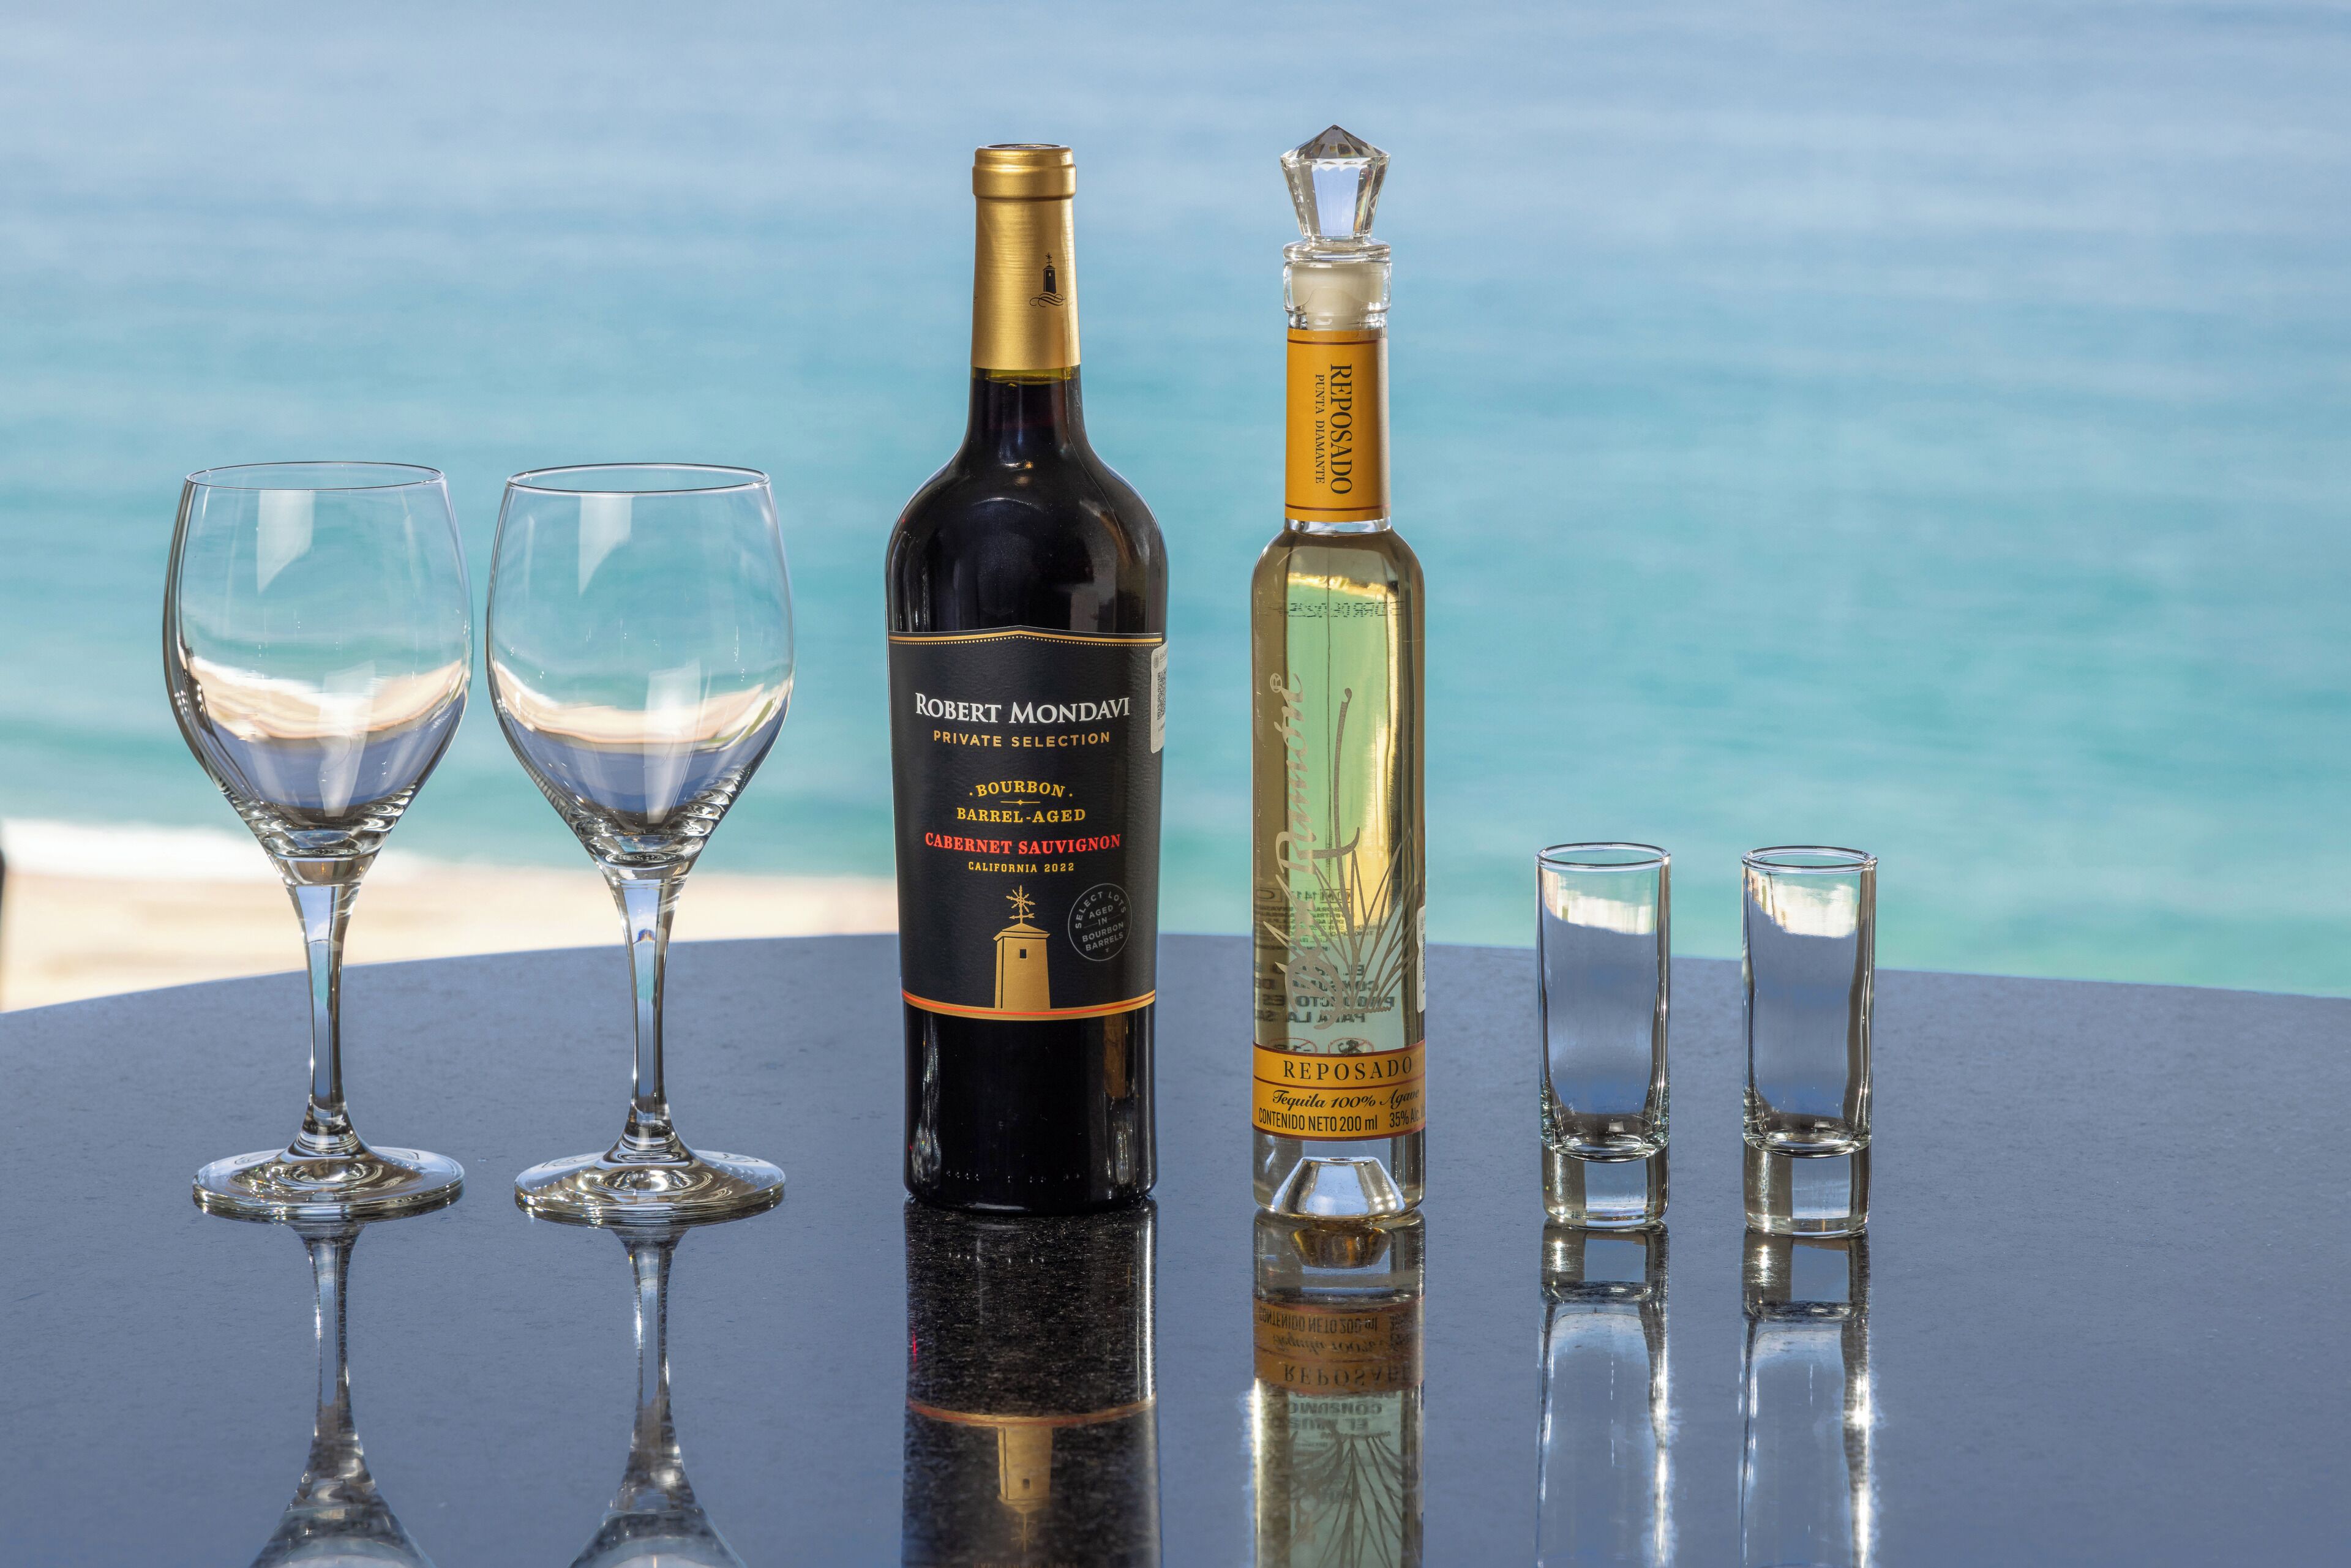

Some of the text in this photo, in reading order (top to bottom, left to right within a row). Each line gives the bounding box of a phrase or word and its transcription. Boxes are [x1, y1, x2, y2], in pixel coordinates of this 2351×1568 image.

[1315, 374, 1325, 484] PUNTA DIAMANTE
[1330, 363, 1352, 494] REPOSADO
[915, 692, 1130, 723] ROBERT MONDAVI
[934, 730, 1110, 748] PRIVATE SELECTION
[976, 781, 1065, 797] BOURBON
[957, 808, 1086, 823] BARREL-AGED
[925, 833, 1121, 855] CABERNET SAUVIGNON
[969, 861, 1074, 872] CALIFORNIA 2022
[1075, 891, 1127, 929] SELECT LOTS
[1089, 905, 1114, 919] AGED
[1082, 921, 1124, 942] BOURBON
[1098, 917, 1107, 926] IN
[1086, 932, 1123, 951] BARRELS
[1283, 1056, 1412, 1081] REPOSADO
[1273, 1088, 1419, 1111] Tequila 100% Agave
[1259, 1107, 1305, 1130] CONTENIDO
[1308, 1115, 1337, 1131] NETO
[1340, 1116, 1362, 1131] 200
[1365, 1114, 1378, 1130] ml
[1389, 1110, 1409, 1128] 35%
